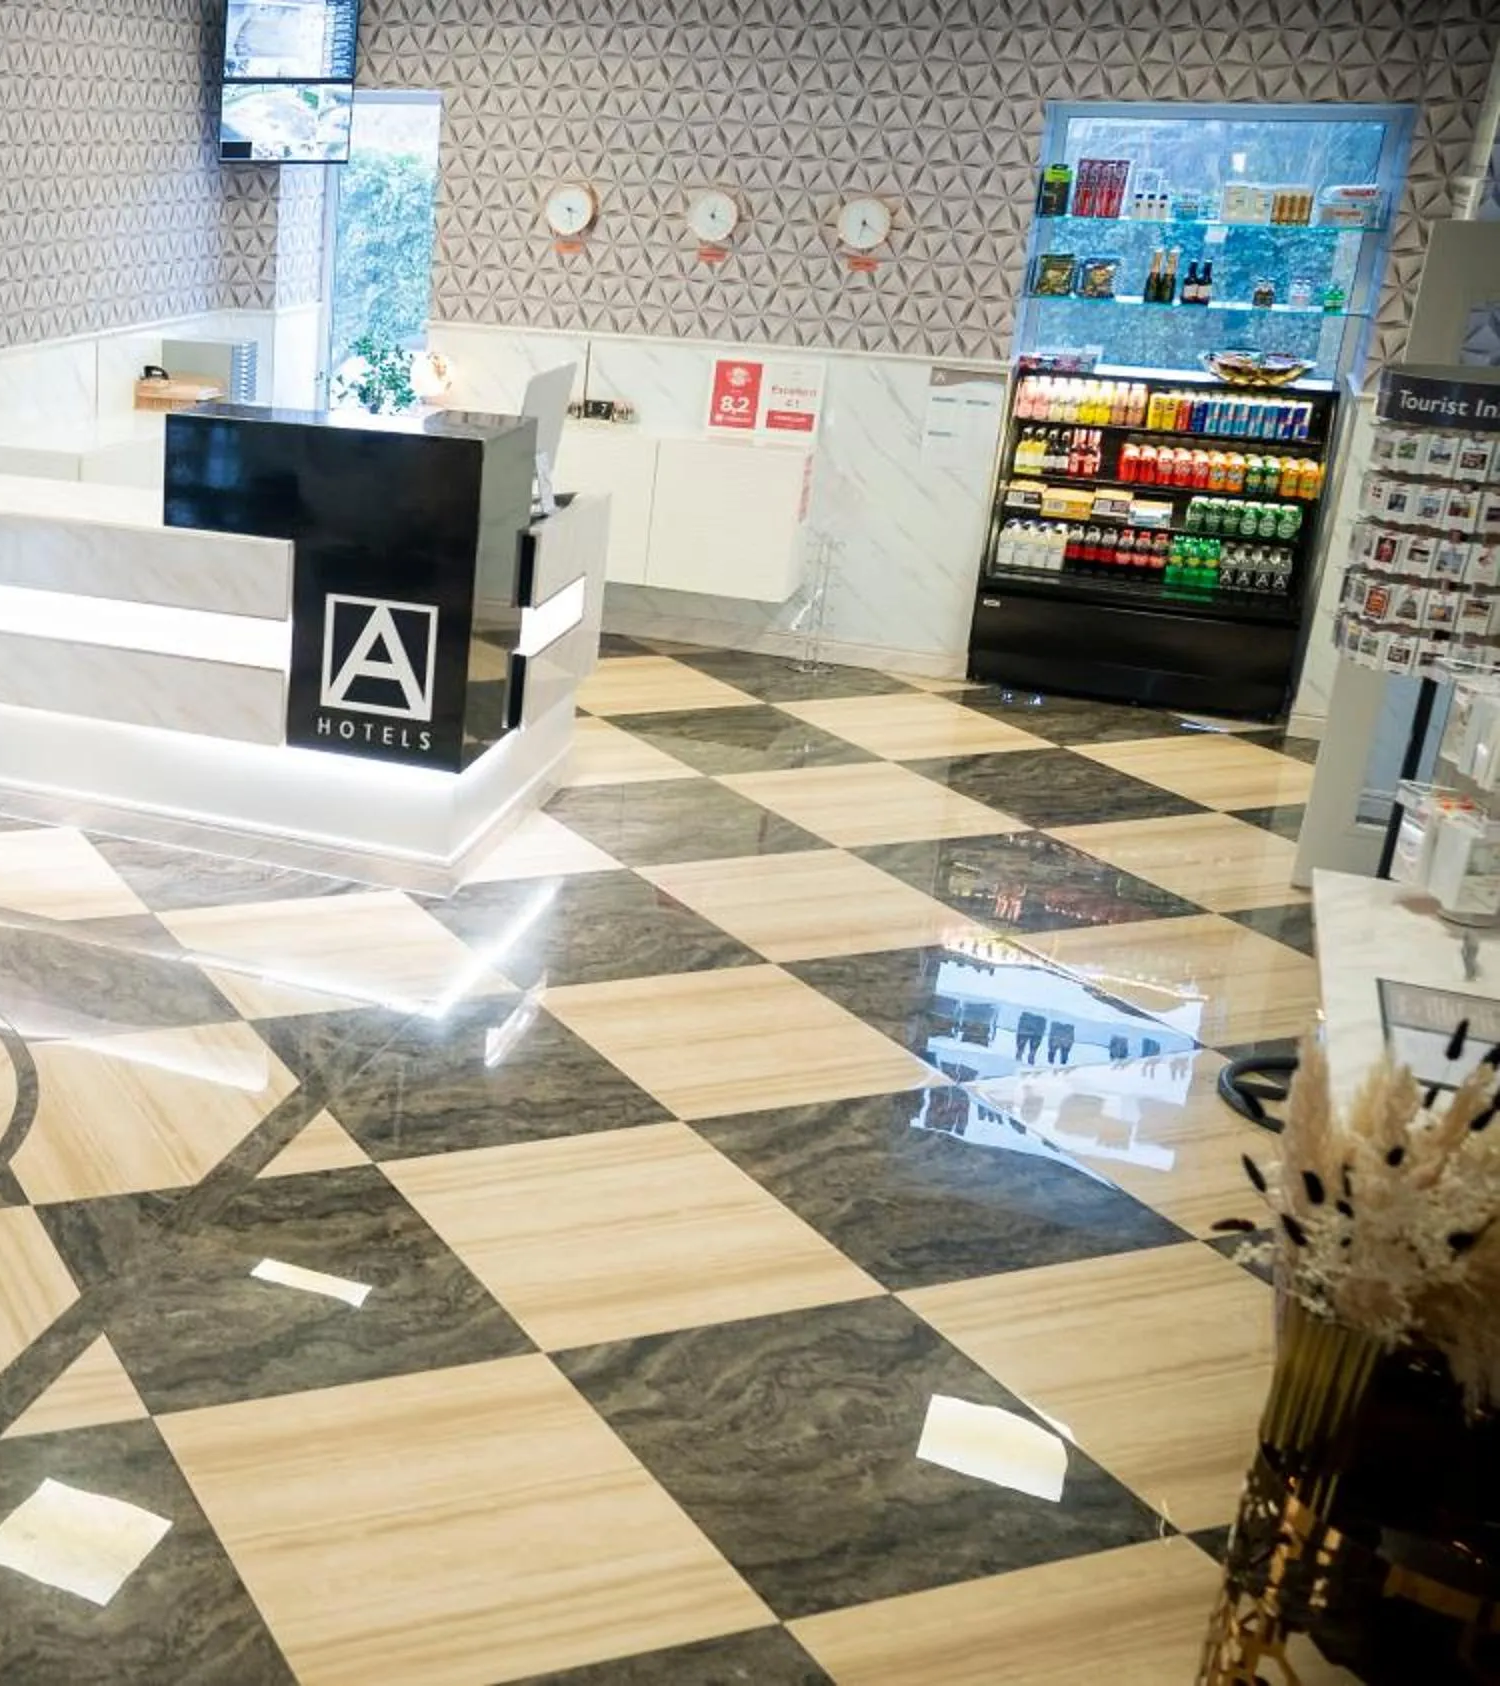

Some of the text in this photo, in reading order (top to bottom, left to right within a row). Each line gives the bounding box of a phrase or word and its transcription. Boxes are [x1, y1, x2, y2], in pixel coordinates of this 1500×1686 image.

[1399, 389, 1500, 417] Tourist In
[320, 599, 432, 721] A
[316, 716, 432, 751] HOTELS
